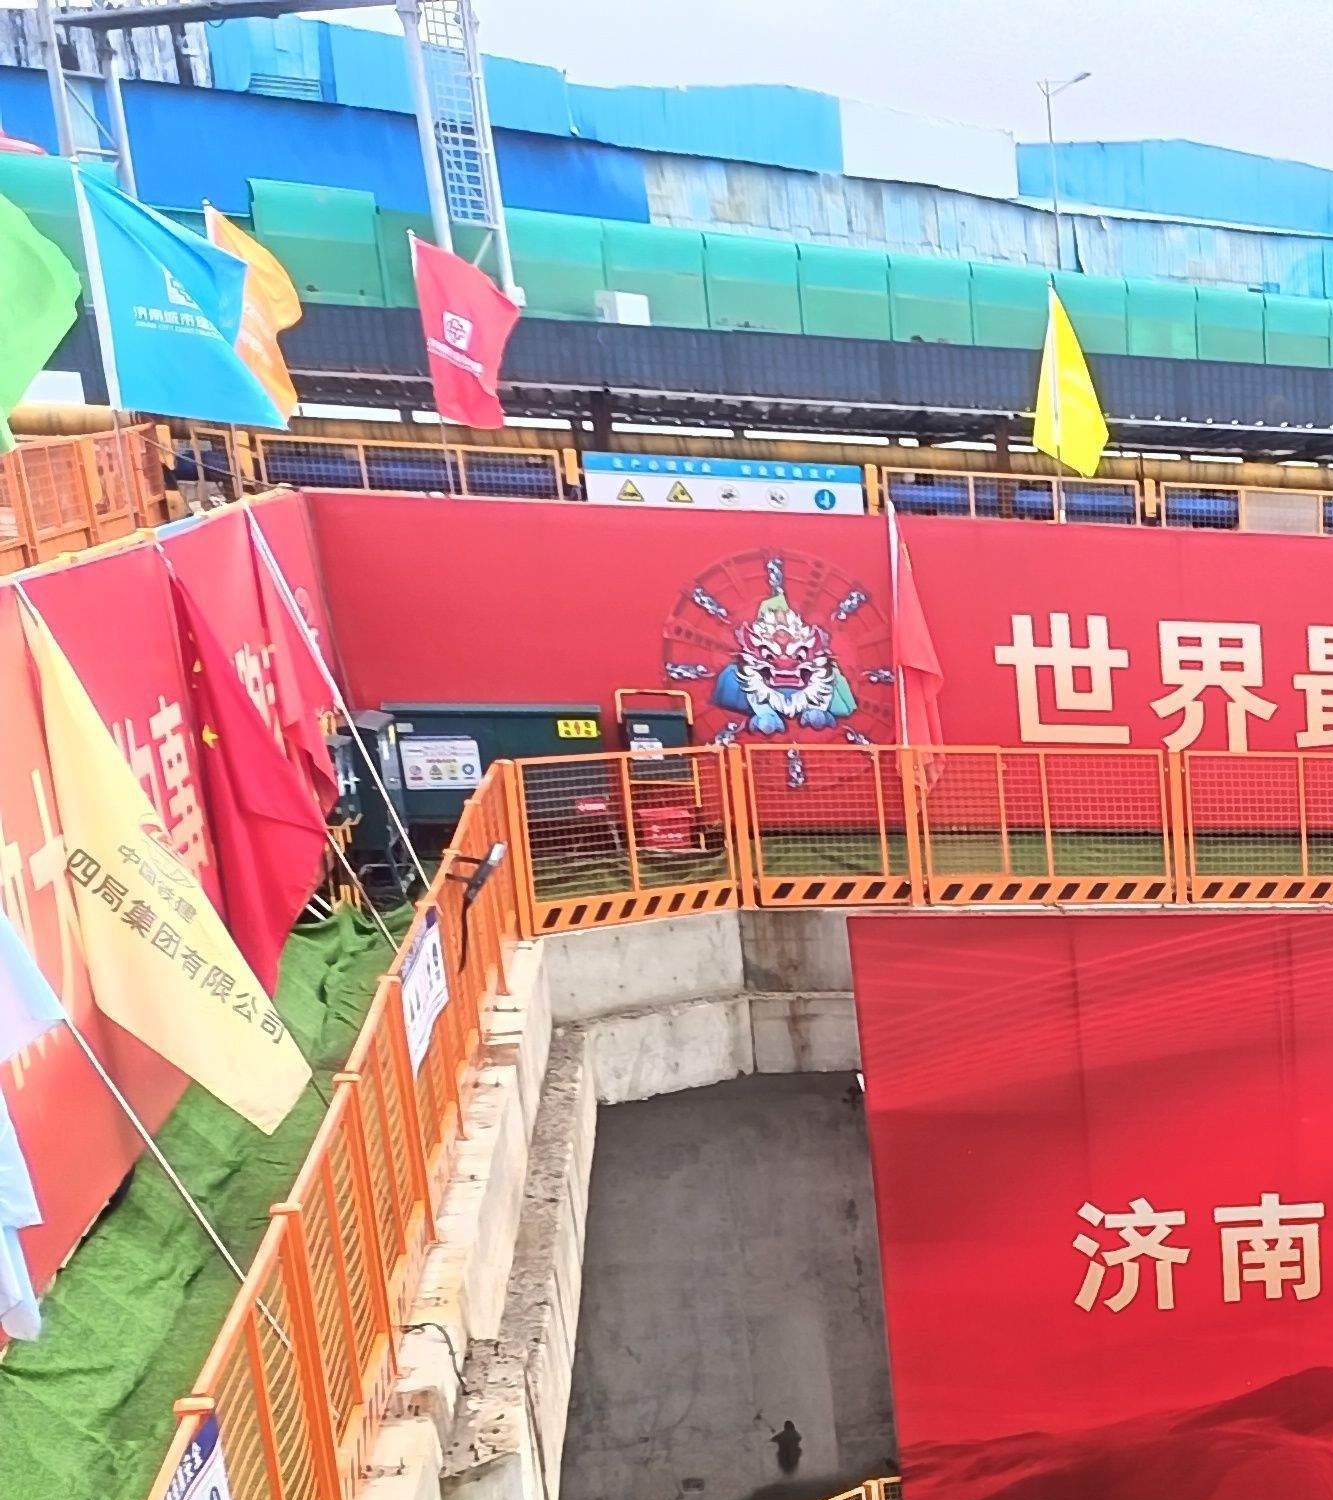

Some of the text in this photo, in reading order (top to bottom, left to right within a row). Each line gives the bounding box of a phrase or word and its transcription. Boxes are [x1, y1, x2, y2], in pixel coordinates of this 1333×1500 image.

[66, 848, 286, 1046] 四局集团有限公司
